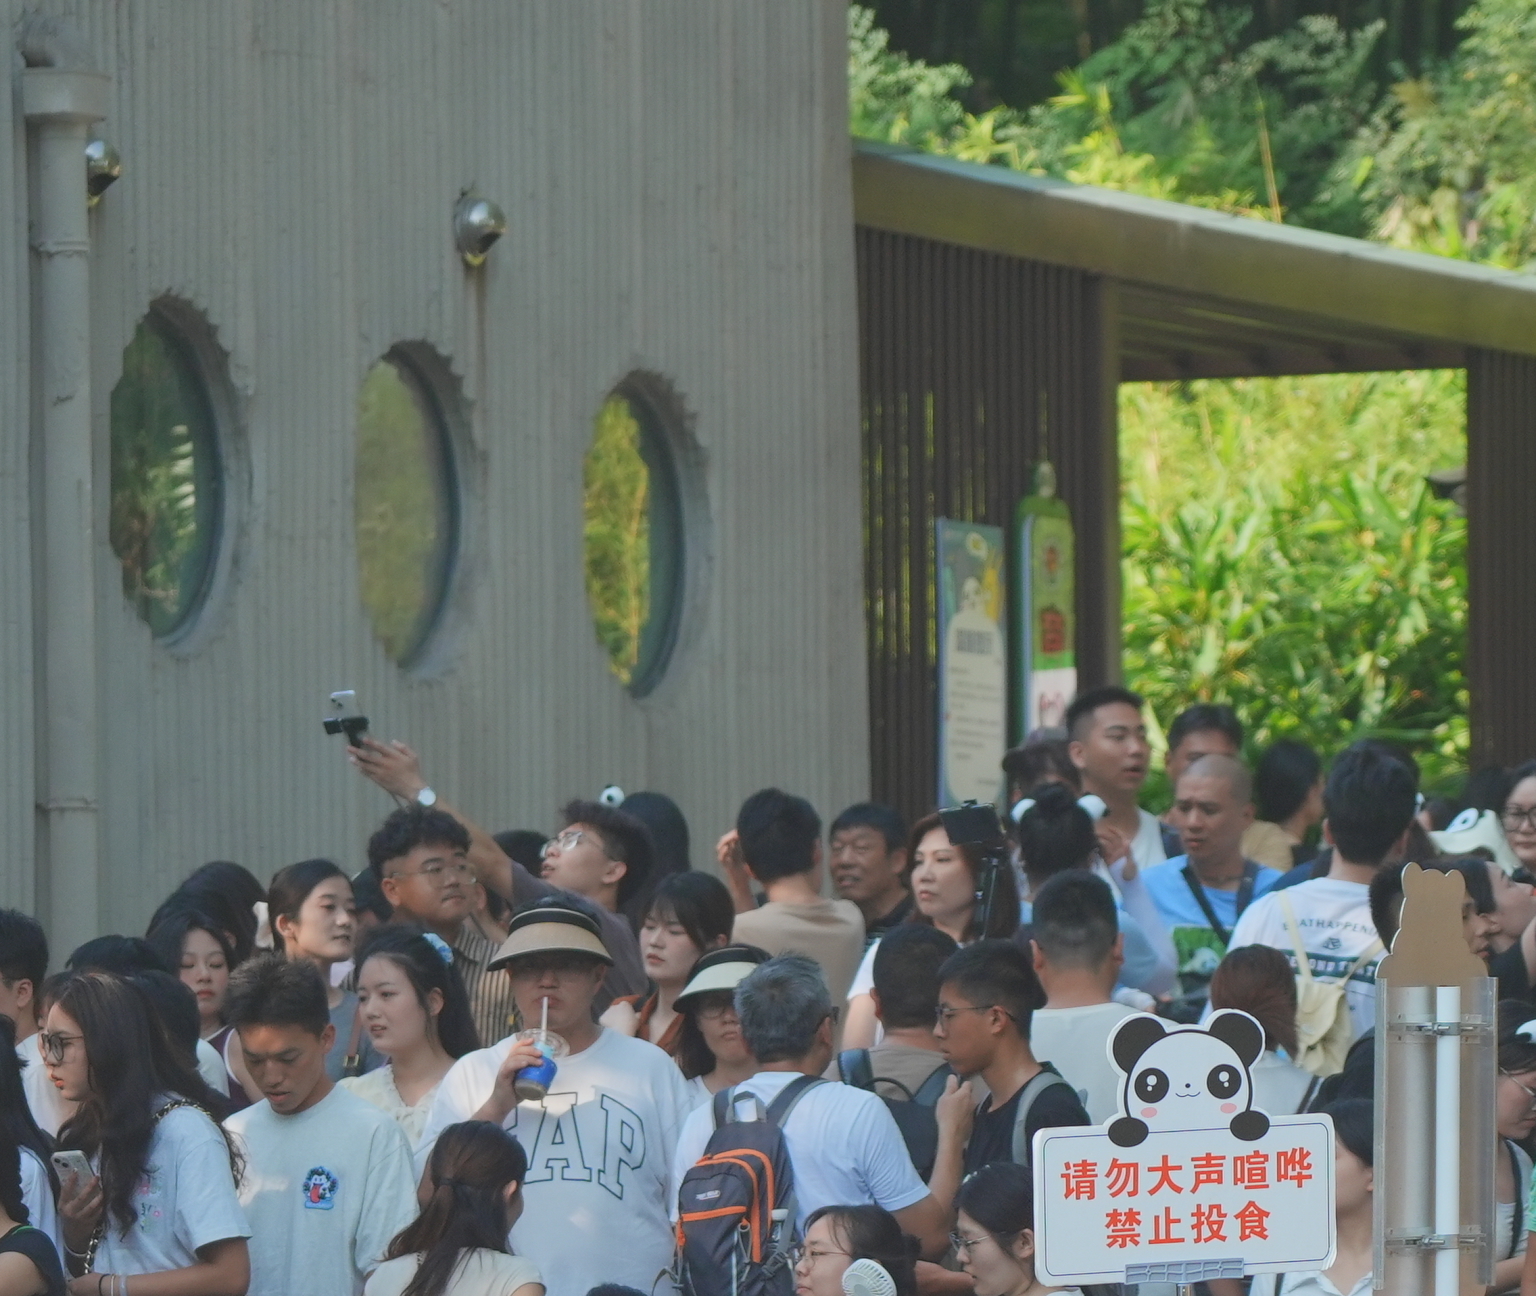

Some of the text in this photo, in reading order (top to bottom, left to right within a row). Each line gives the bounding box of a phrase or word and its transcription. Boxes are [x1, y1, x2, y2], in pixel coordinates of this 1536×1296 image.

[505, 1091, 646, 1201] AP
[1061, 1147, 1313, 1201] 请勿大声喧哗
[1105, 1200, 1271, 1248] 禁止投食
